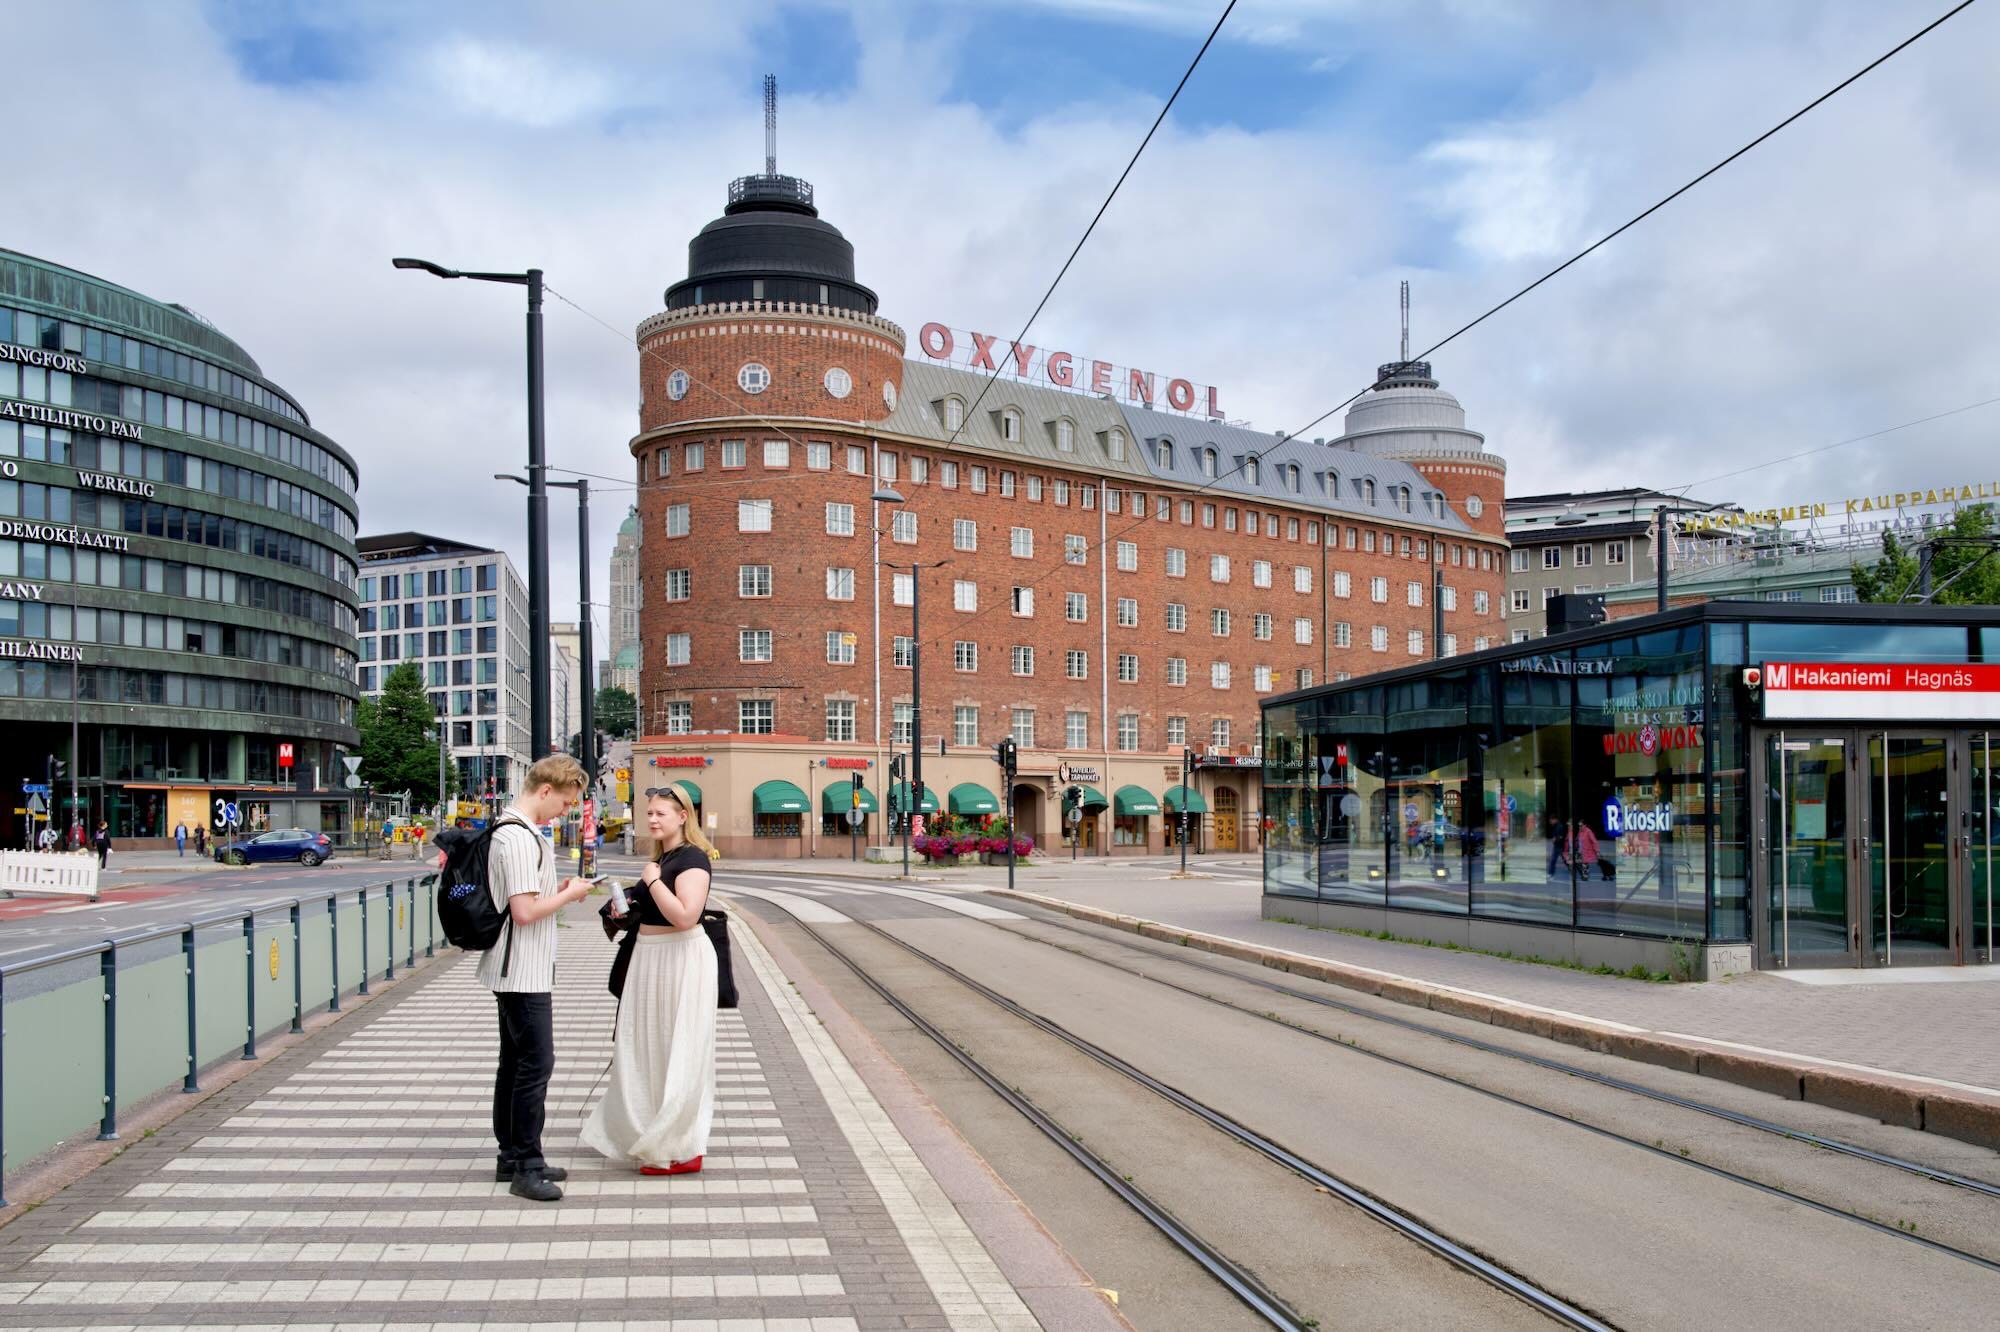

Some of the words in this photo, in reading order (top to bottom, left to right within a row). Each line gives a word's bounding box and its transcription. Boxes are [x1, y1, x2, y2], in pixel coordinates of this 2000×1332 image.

[0, 343, 87, 374] SINGFORS
[919, 322, 1225, 419] OXYGENOL
[0, 401, 106, 432] ATTILIITTO
[111, 419, 143, 440] PAM
[78, 471, 155, 498] WERKLIG
[1685, 503, 1827, 533] HAKANIEMEN
[1846, 481, 2000, 513] KAUPPAHALL
[0, 521, 129, 551] DEMOKRAATTI
[0, 582, 44, 600] ANY
[1766, 665, 1788, 688] M
[1794, 668, 1892, 686] Hakaniemi
[1905, 669, 1973, 688] Hagnäs
[280, 744, 293, 757] M
[1603, 731, 1638, 755] WOK
[1659, 724, 1700, 751] WOK
[1606, 804, 1619, 831] R
[1624, 803, 1673, 831] kioski
